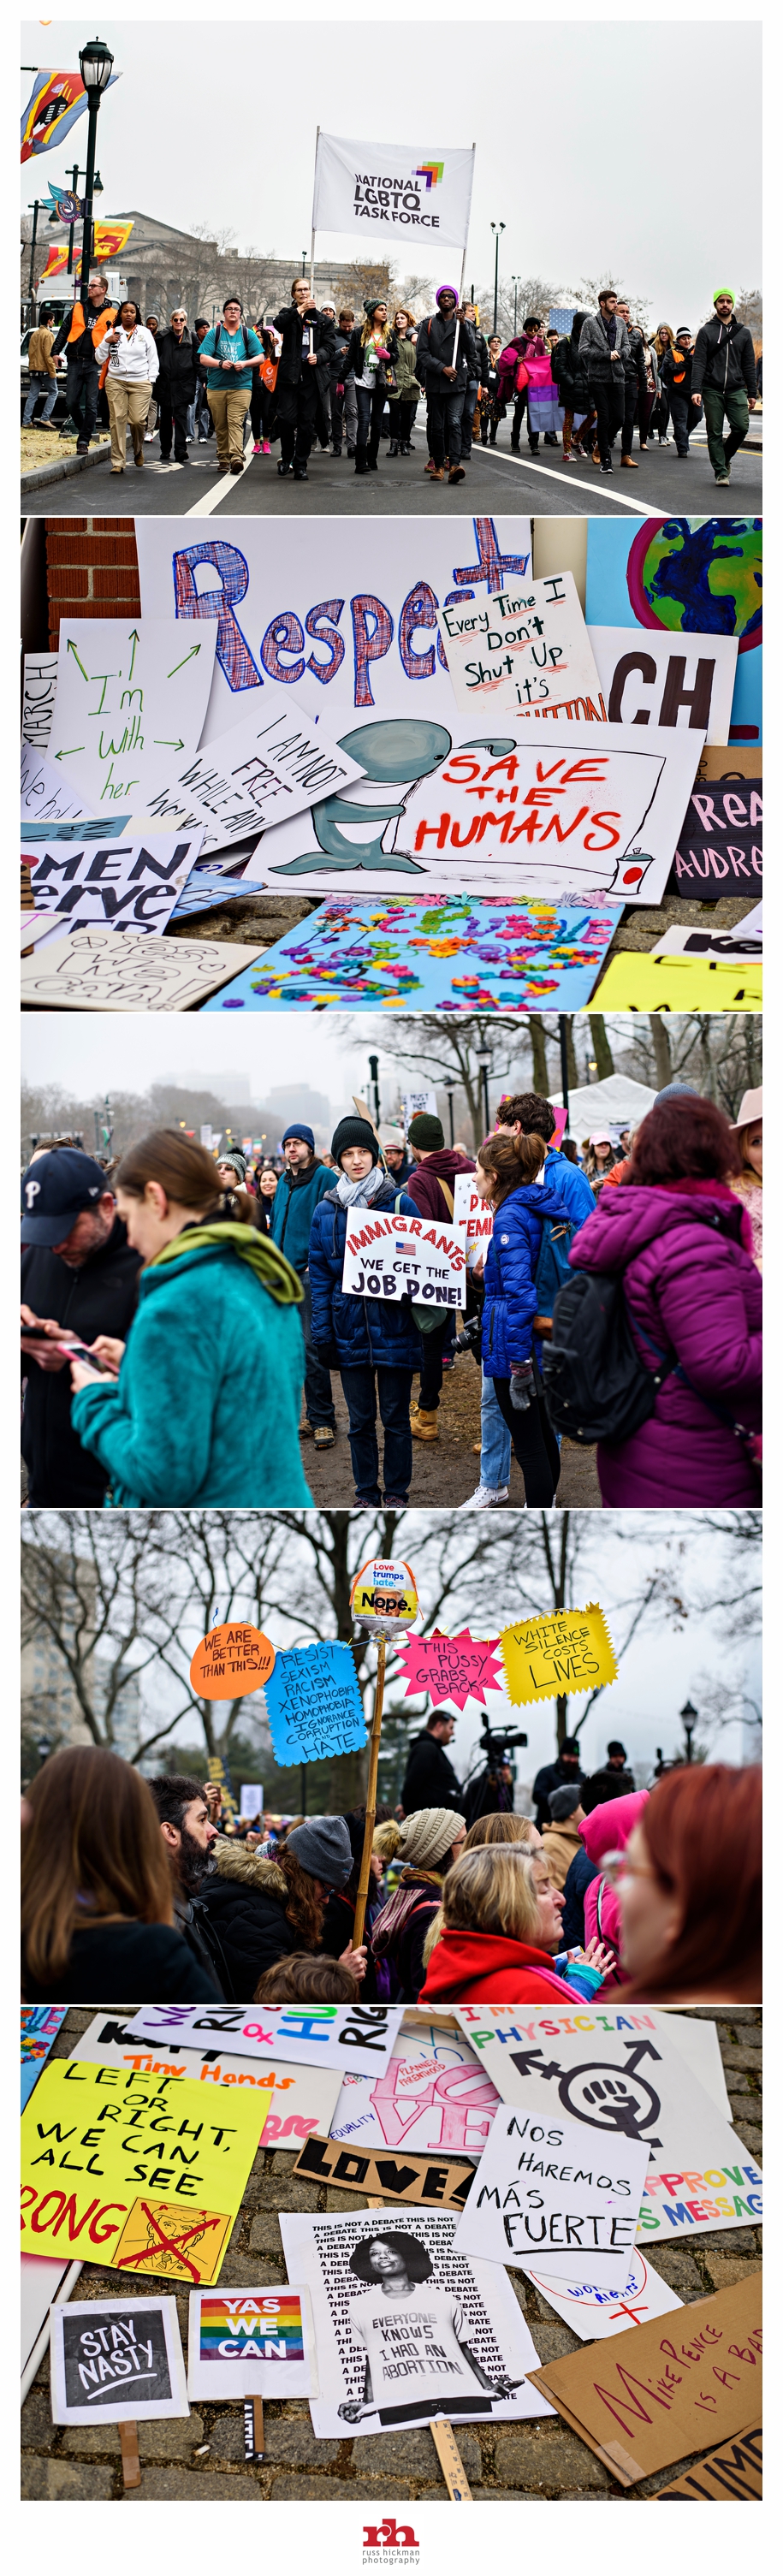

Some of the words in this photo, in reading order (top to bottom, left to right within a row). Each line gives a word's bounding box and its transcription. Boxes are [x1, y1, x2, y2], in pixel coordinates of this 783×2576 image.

[355, 174, 421, 192] NATIONAL
[68, 191, 80, 211] PHLASH
[354, 185, 420, 211] LGBTQ
[353, 204, 389, 221] TASK
[391, 211, 440, 228] FORCE
[442, 608, 490, 638] Every
[493, 594, 537, 617] Time
[543, 578, 566, 602] I
[487, 616, 544, 650] Don't
[465, 656, 513, 686] Shut
[88, 670, 144, 715] I'm
[515, 677, 549, 704] it's
[22, 661, 58, 748] MARCH
[513, 693, 608, 722] TTON
[258, 714, 287, 739] I
[268, 733, 319, 771] AM
[231, 757, 294, 808] FREE
[292, 754, 347, 796] NOT
[442, 754, 609, 785] SAVE
[178, 758, 244, 814] WHILE
[465, 785, 566, 806] THE
[414, 806, 622, 852] HUMANS
[25, 1181, 41, 1208] P
[346, 1216, 466, 1272] IMMIGRANTS
[360, 1258, 384, 1271] WE
[393, 1261, 422, 1275] GET
[426, 1267, 450, 1279] THE
[351, 1273, 397, 1296] JOB
[406, 1279, 462, 1307] DONE!
[373, 1570, 404, 1581] trumps
[373, 1578, 396, 1587] hate.
[362, 1593, 412, 1613] Nope.
[205, 1634, 221, 1652] WE
[227, 1629, 252, 1644] ARE
[513, 1621, 567, 1646] WHITE
[525, 1626, 590, 1654] SILENCE
[212, 1644, 259, 1661] BETTER
[282, 1645, 337, 1669] RESIST
[418, 1642, 458, 1654] THIS
[543, 1640, 589, 1660] COSTS
[200, 1663, 225, 1678] THAN
[228, 1656, 271, 1673] THIS!!!
[281, 1662, 330, 1684] SEXISM
[416, 1669, 468, 1683] GRABS
[438, 1654, 489, 1677] PUSSY
[529, 1652, 600, 1689] LIVES
[278, 1685, 354, 1712] XENOPHOBIA
[285, 1675, 336, 1698] RACISM
[285, 1698, 356, 1725] HOMOPHOBIA
[294, 1709, 355, 1734] IGNORANCE
[286, 1717, 359, 1744] CORRUPTION
[313, 1734, 330, 1742] AND
[302, 1732, 356, 1759] HATE
[470, 2015, 656, 2049] PHYSICIAN
[200, 2064, 296, 2090] Hands
[399, 2059, 438, 2076] PLANNED
[399, 2064, 446, 2086] PARENTHOOD
[122, 2094, 169, 2112] OR
[97, 2104, 238, 2152] RIGHT,
[329, 2113, 376, 2140] EQUALITY
[507, 2116, 564, 2146] NOS
[37, 2122, 105, 2147] WE
[122, 2134, 199, 2165] CAN
[31, 2148, 104, 2175] ALL
[124, 2163, 204, 2197] SEE
[518, 2152, 631, 2196] HAREMOS
[643, 2166, 762, 2197] PPROVE
[477, 2181, 545, 2209] MÁS
[323, 2228, 357, 2237] DEBATE
[503, 2213, 638, 2247] FUERTE
[222, 2298, 281, 2314] YAS
[225, 2318, 279, 2336] WE
[372, 2312, 437, 2329] EVERYONE
[382, 2325, 434, 2342] KNOWS
[80, 2319, 137, 2358] STAY
[217, 2339, 287, 2359] CAN
[659, 2324, 723, 2369] PENCE
[78, 2340, 154, 2390] NASTY
[341, 2355, 362, 2364] THIS
[379, 2350, 390, 2361] I
[391, 2343, 419, 2358] HAD
[424, 2344, 447, 2358] AN
[344, 2376, 366, 2384] THIS
[383, 2359, 464, 2381] ABORTION
[694, 2392, 717, 2413] IS
[713, 2366, 740, 2389] A
